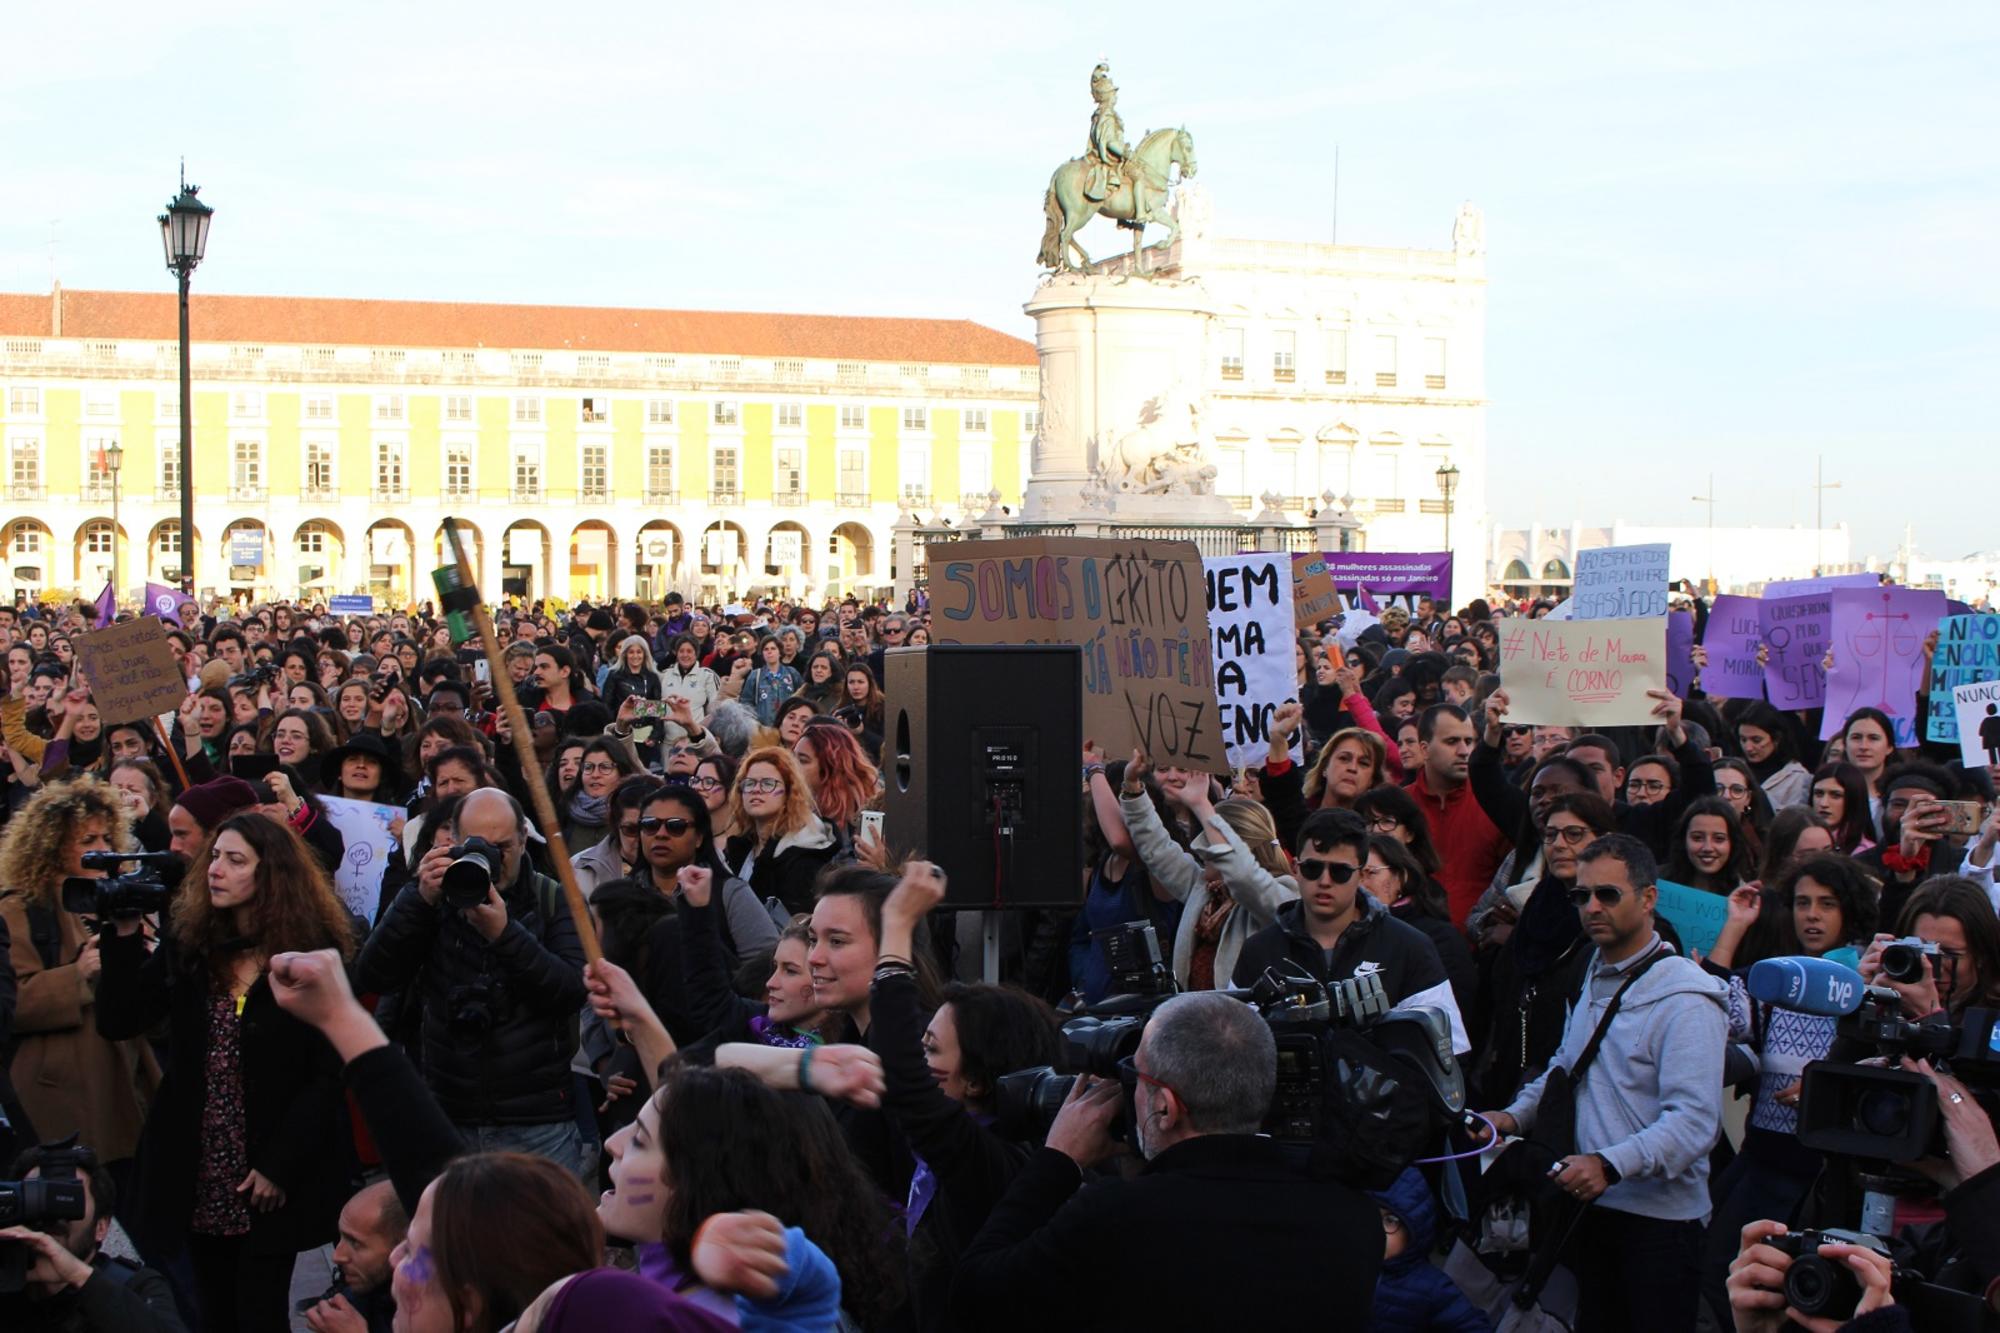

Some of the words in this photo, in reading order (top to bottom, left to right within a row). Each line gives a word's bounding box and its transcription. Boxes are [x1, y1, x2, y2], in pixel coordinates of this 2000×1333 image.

[1336, 563, 1378, 571] mulheres
[1378, 563, 1433, 571] assassinadas
[944, 555, 1074, 621] SOMOS
[1082, 558, 1101, 621] O
[1104, 548, 1188, 631] GRITO
[1209, 621, 1265, 660] MA
[1578, 636, 1600, 663] de
[1084, 625, 1112, 695] JÁ
[1115, 628, 1159, 679] NÃO
[1162, 627, 1210, 688] TÊM
[1545, 667, 1559, 689] É
[1567, 669, 1624, 693] CORNO
[1125, 689, 1210, 761] VOZ
[1788, 975, 1801, 998] tve
[1828, 974, 1853, 1009] tve
